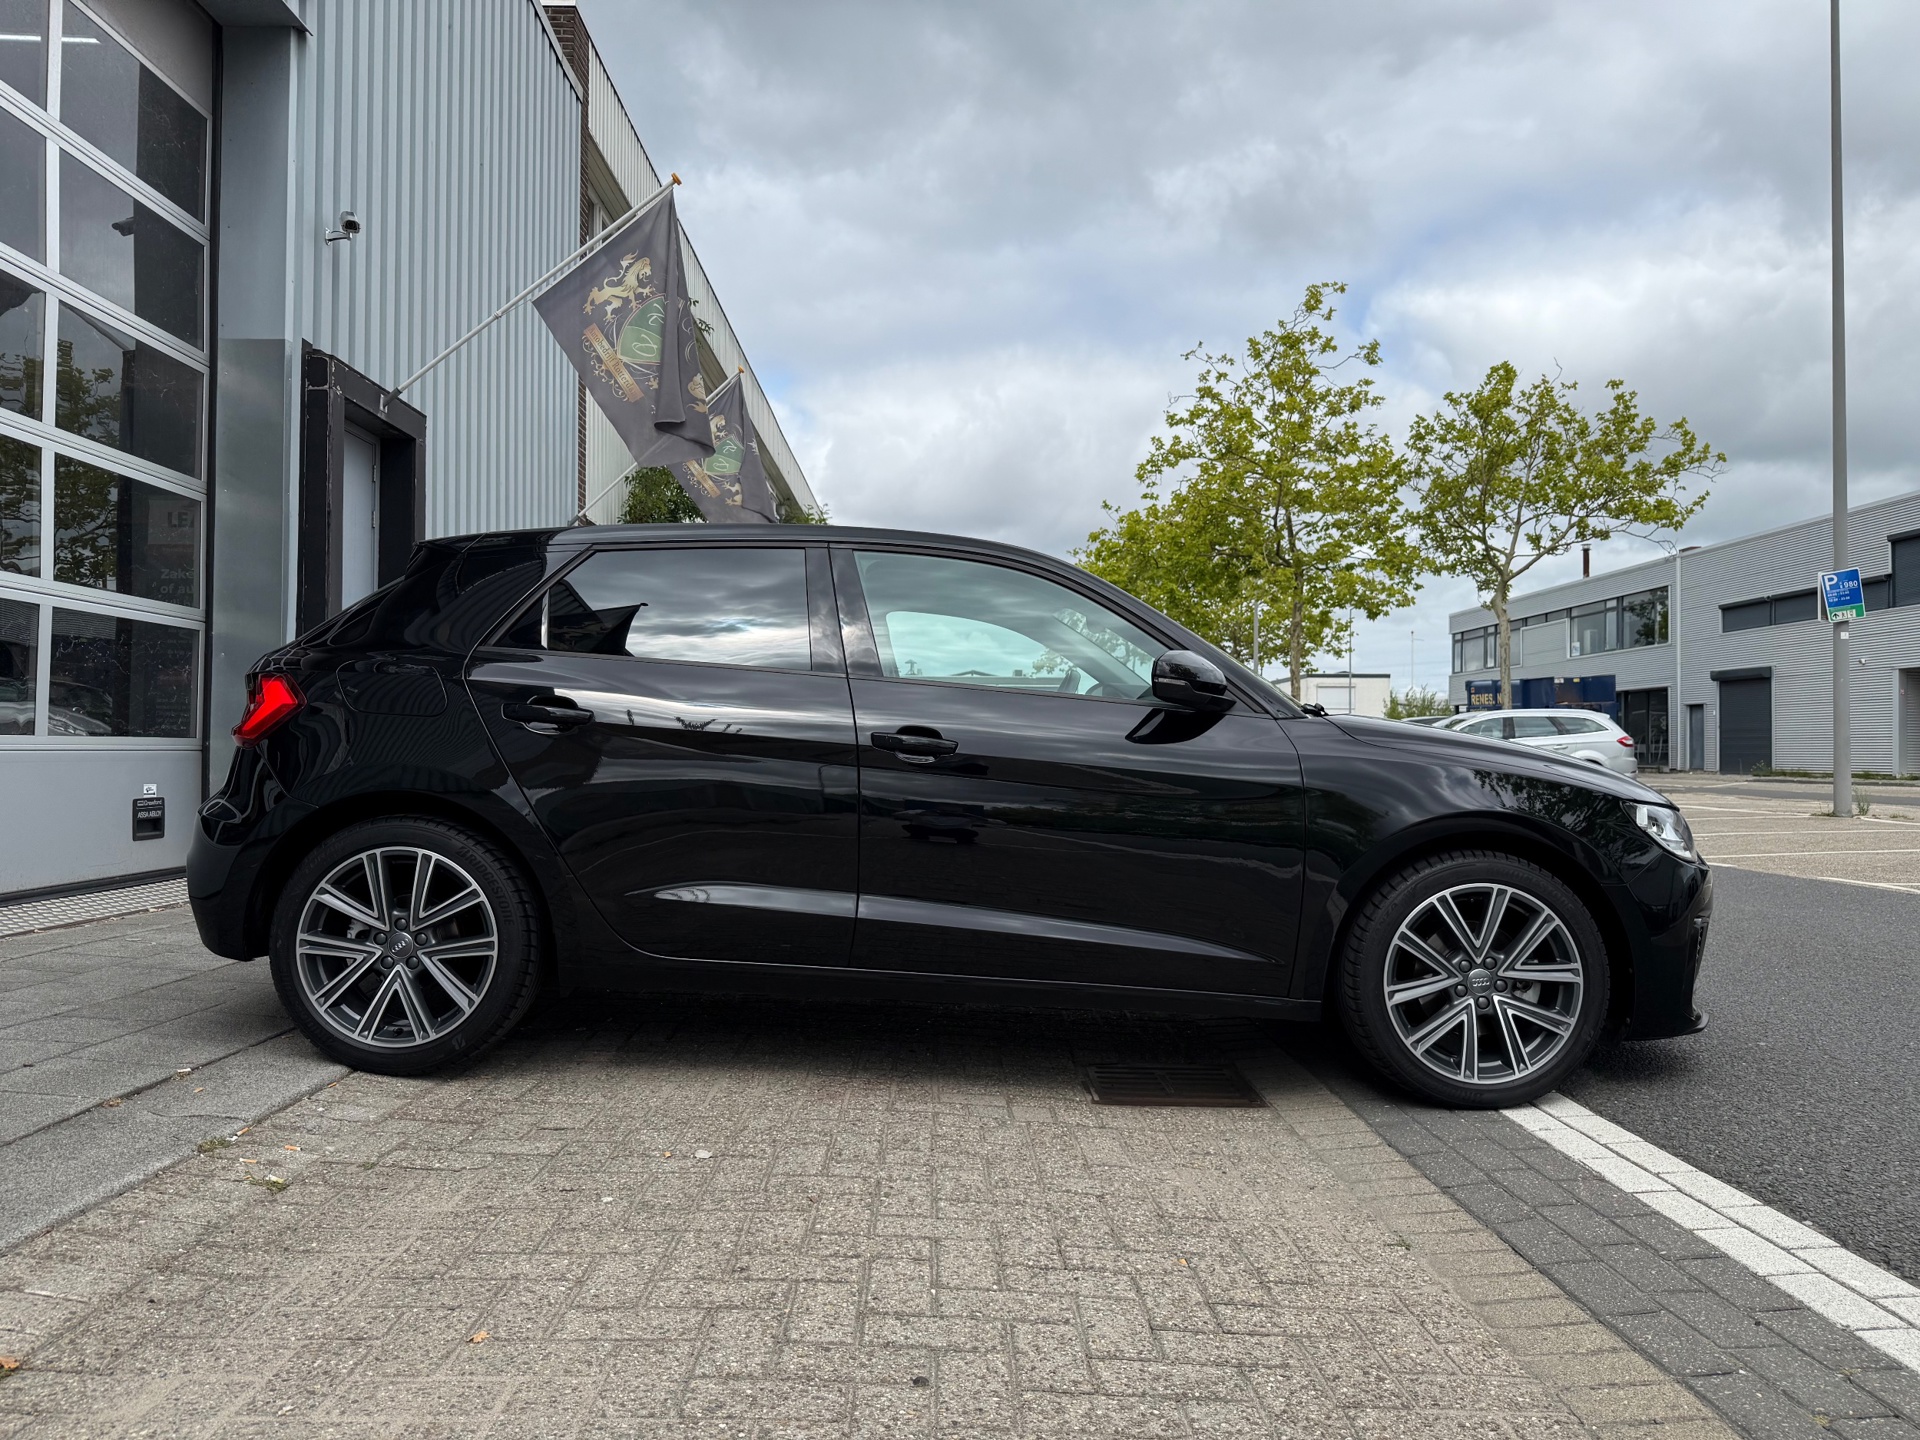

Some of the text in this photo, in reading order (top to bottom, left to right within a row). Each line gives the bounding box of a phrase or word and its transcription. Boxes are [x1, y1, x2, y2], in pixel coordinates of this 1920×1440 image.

[586, 325, 617, 364] Autobedrijf
[160, 584, 174, 594] of
[1824, 574, 1838, 590] P
[457, 844, 516, 926] BRIDGESTONE
